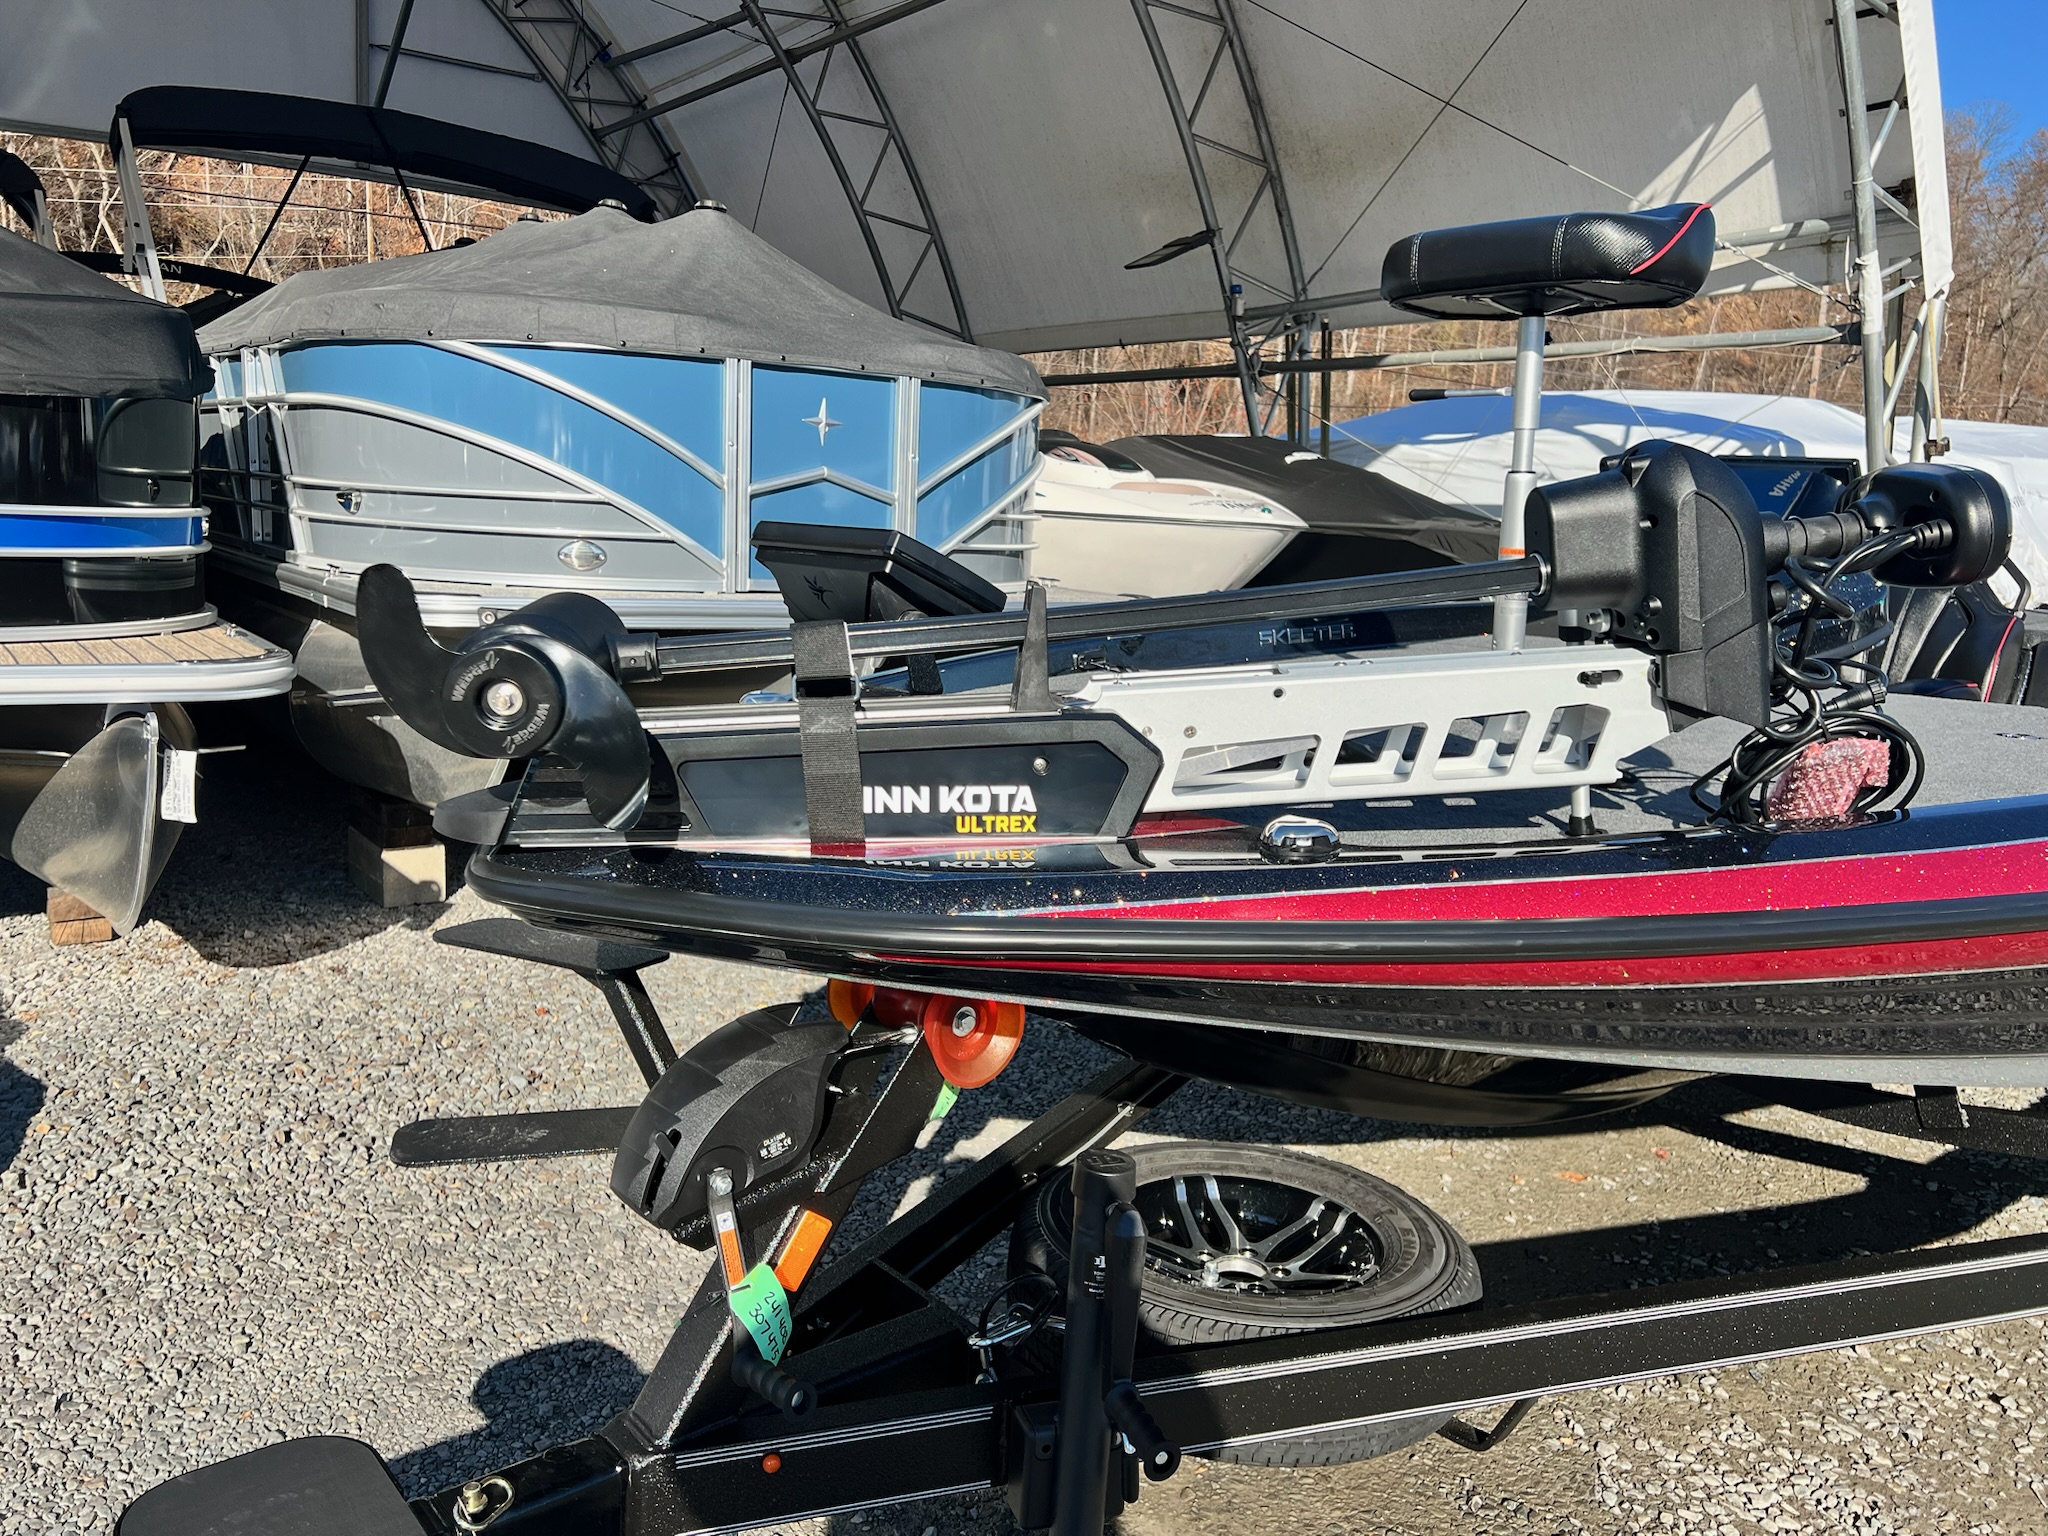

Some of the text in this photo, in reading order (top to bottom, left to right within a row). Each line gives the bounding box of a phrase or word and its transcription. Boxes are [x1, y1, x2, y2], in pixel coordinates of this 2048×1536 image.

[1259, 623, 1357, 647] SKEETER
[862, 785, 1038, 814] INN KOTA
[956, 815, 1037, 833] ULTREX
[764, 1291, 783, 1318] 241
[748, 1302, 780, 1361] 307 475
